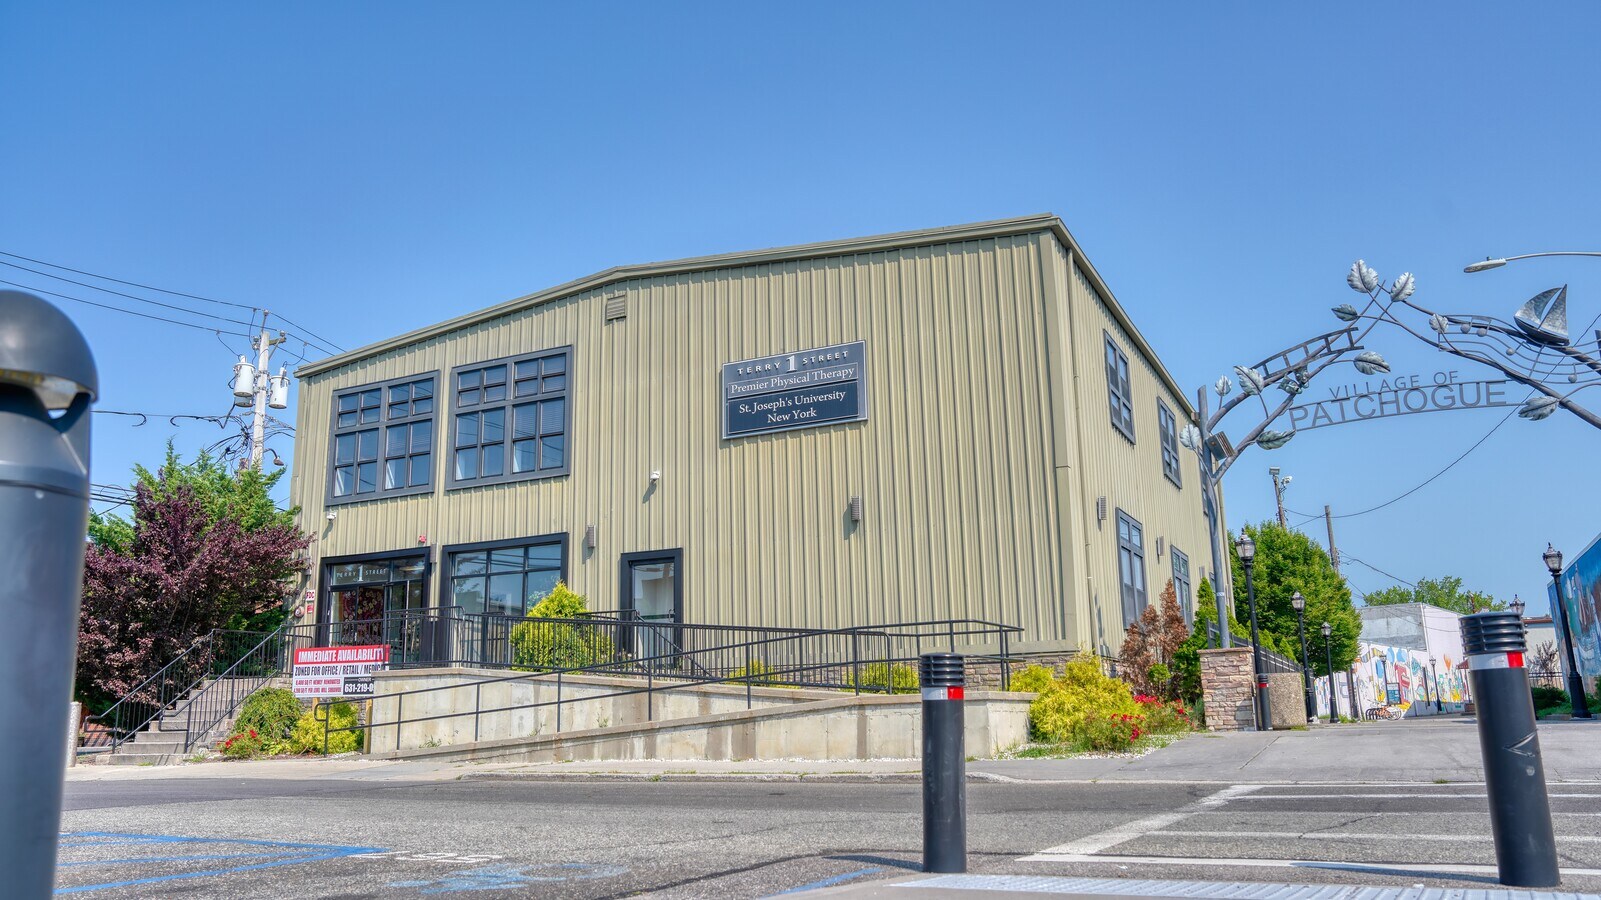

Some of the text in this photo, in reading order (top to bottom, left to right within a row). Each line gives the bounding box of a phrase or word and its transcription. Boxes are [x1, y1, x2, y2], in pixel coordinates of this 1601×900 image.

[737, 351, 848, 375] TERRY 1 STREET
[731, 367, 855, 393] Premier Physical Therapy
[1329, 370, 1459, 399] VILLAGE OF
[739, 391, 846, 414] St. Joseph's University
[1289, 381, 1507, 431] PATCHOGUE
[767, 408, 817, 423] New York
[358, 565, 364, 582] 1
[365, 567, 388, 575] STREET
[298, 648, 383, 662] IMMEDIATE AVAILABILITY
[295, 666, 310, 676] ZONED
[311, 666, 321, 675] FOR
[321, 665, 338, 675] OFFICE
[342, 664, 359, 674] RETAIL
[345, 683, 374, 692] 631-219-0
